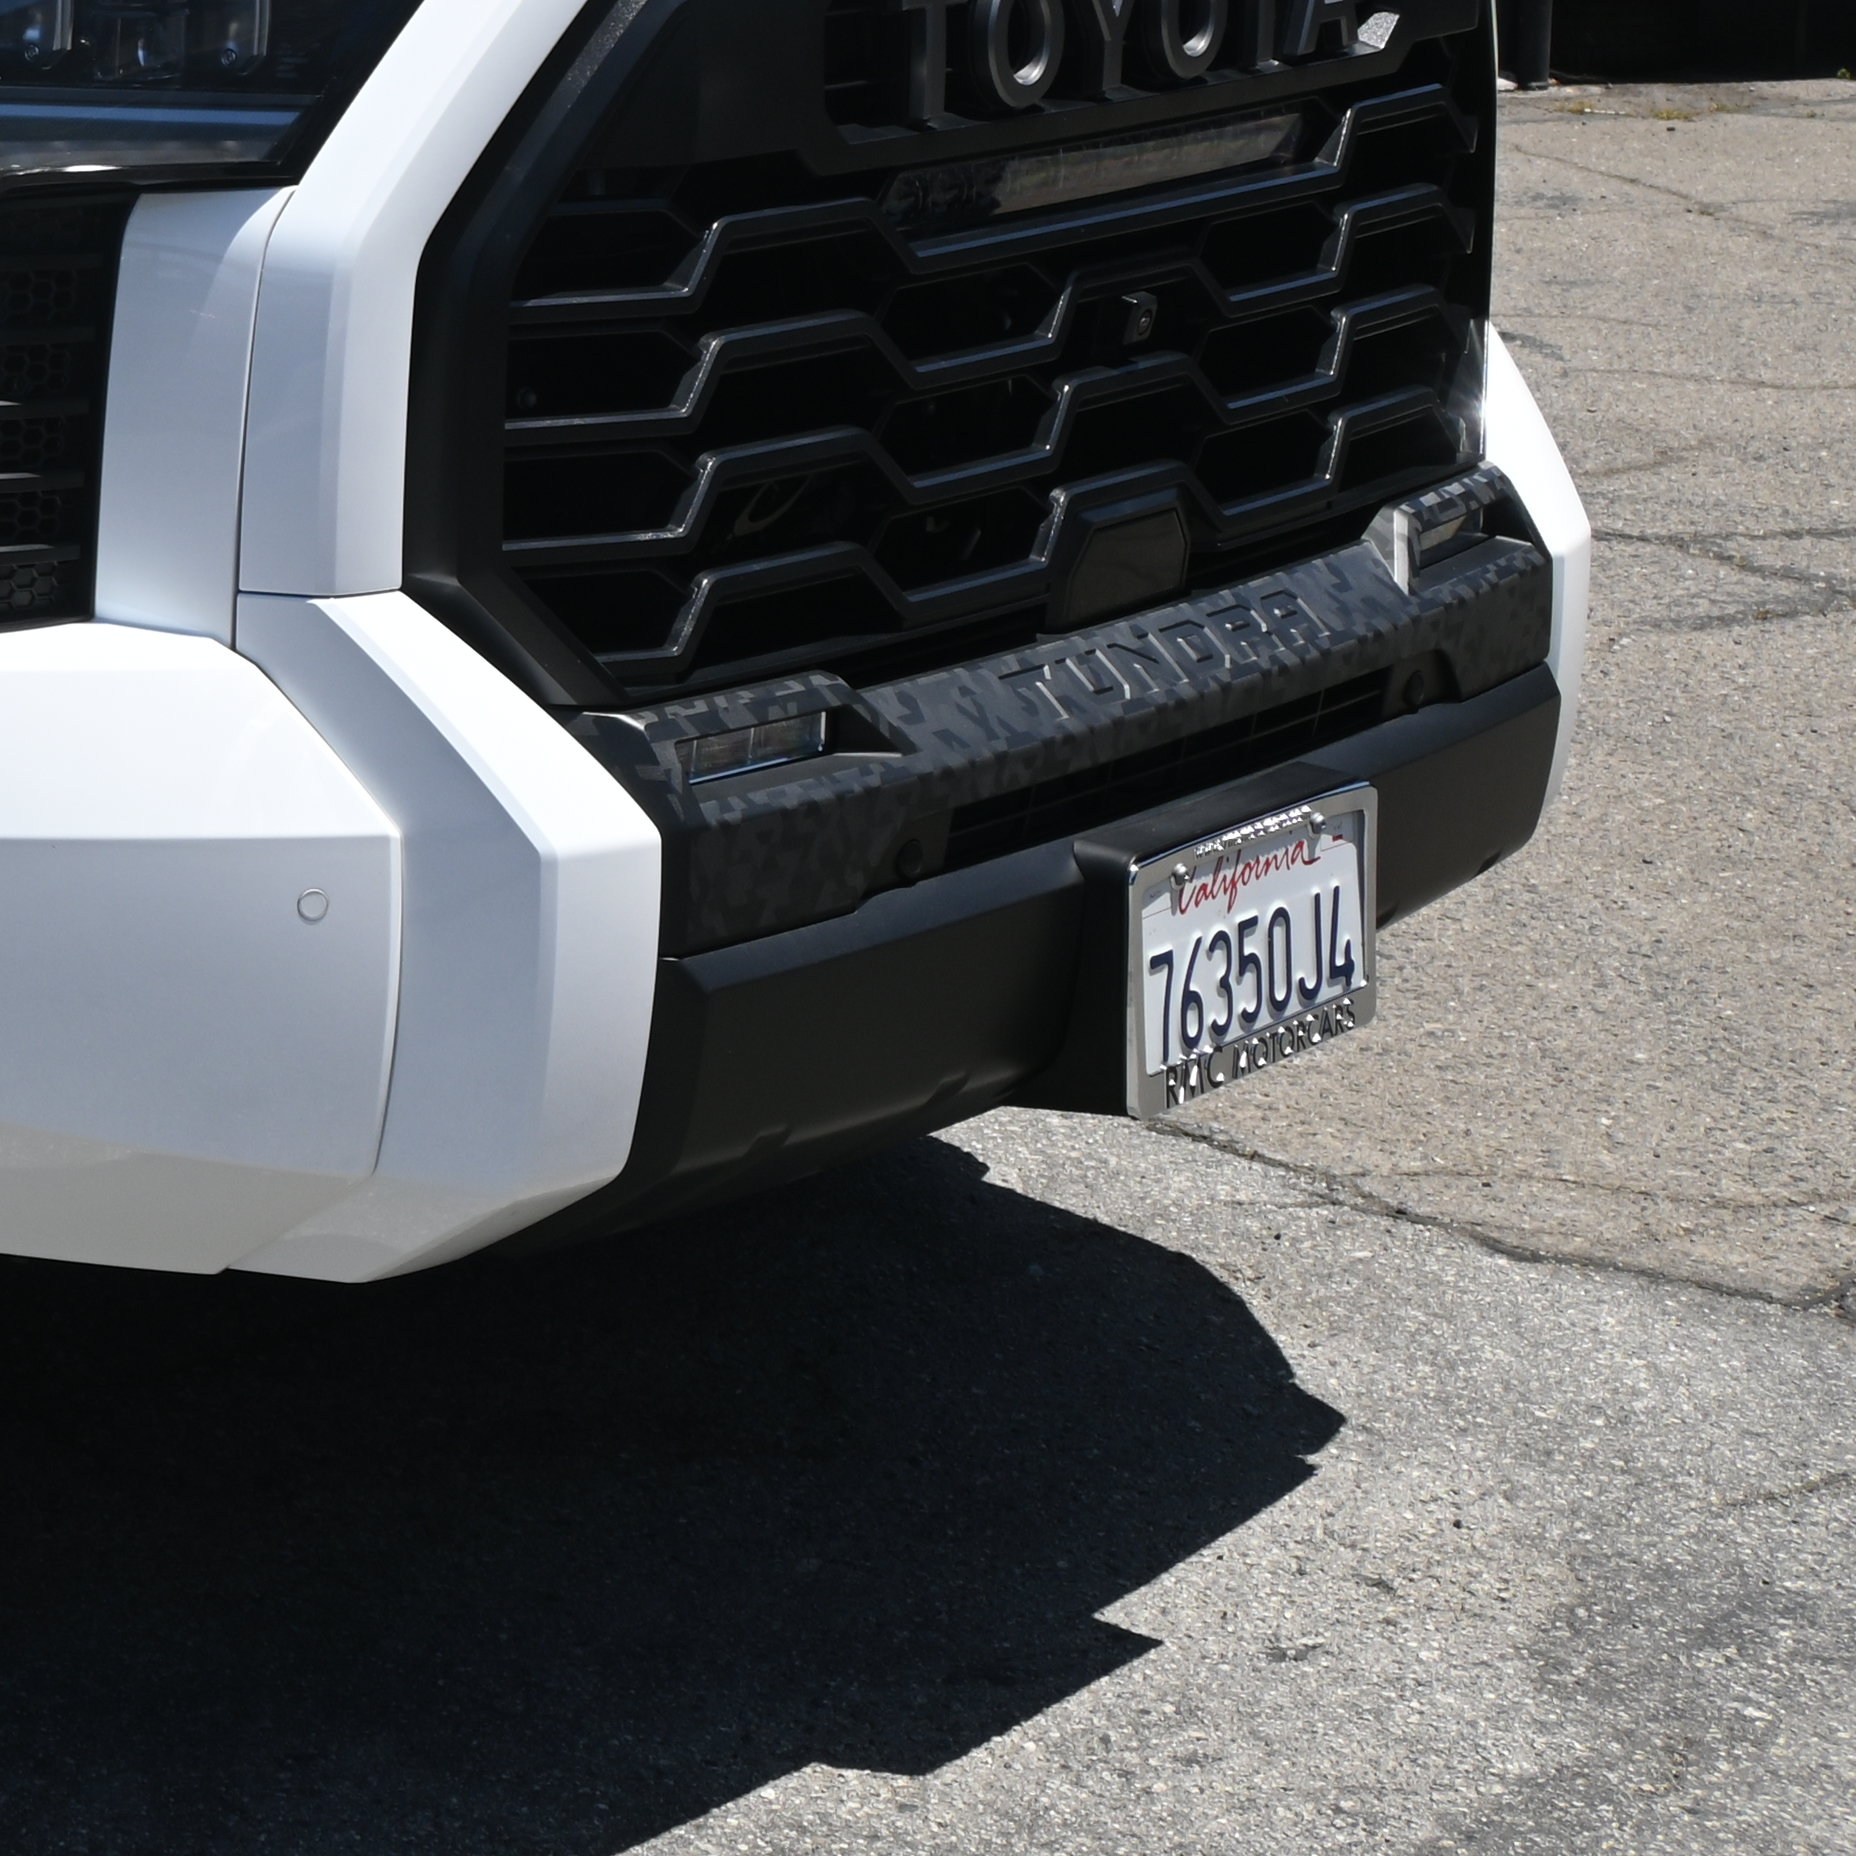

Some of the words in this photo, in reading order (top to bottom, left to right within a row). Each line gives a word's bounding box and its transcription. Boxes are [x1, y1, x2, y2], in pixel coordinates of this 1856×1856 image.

[998, 588, 1332, 723] TUNDRA
[1177, 840, 1321, 915] California
[1148, 884, 1356, 1062] 76350J4
[1164, 1044, 1225, 1109] RMC
[1232, 997, 1356, 1080] MOTORCARS
